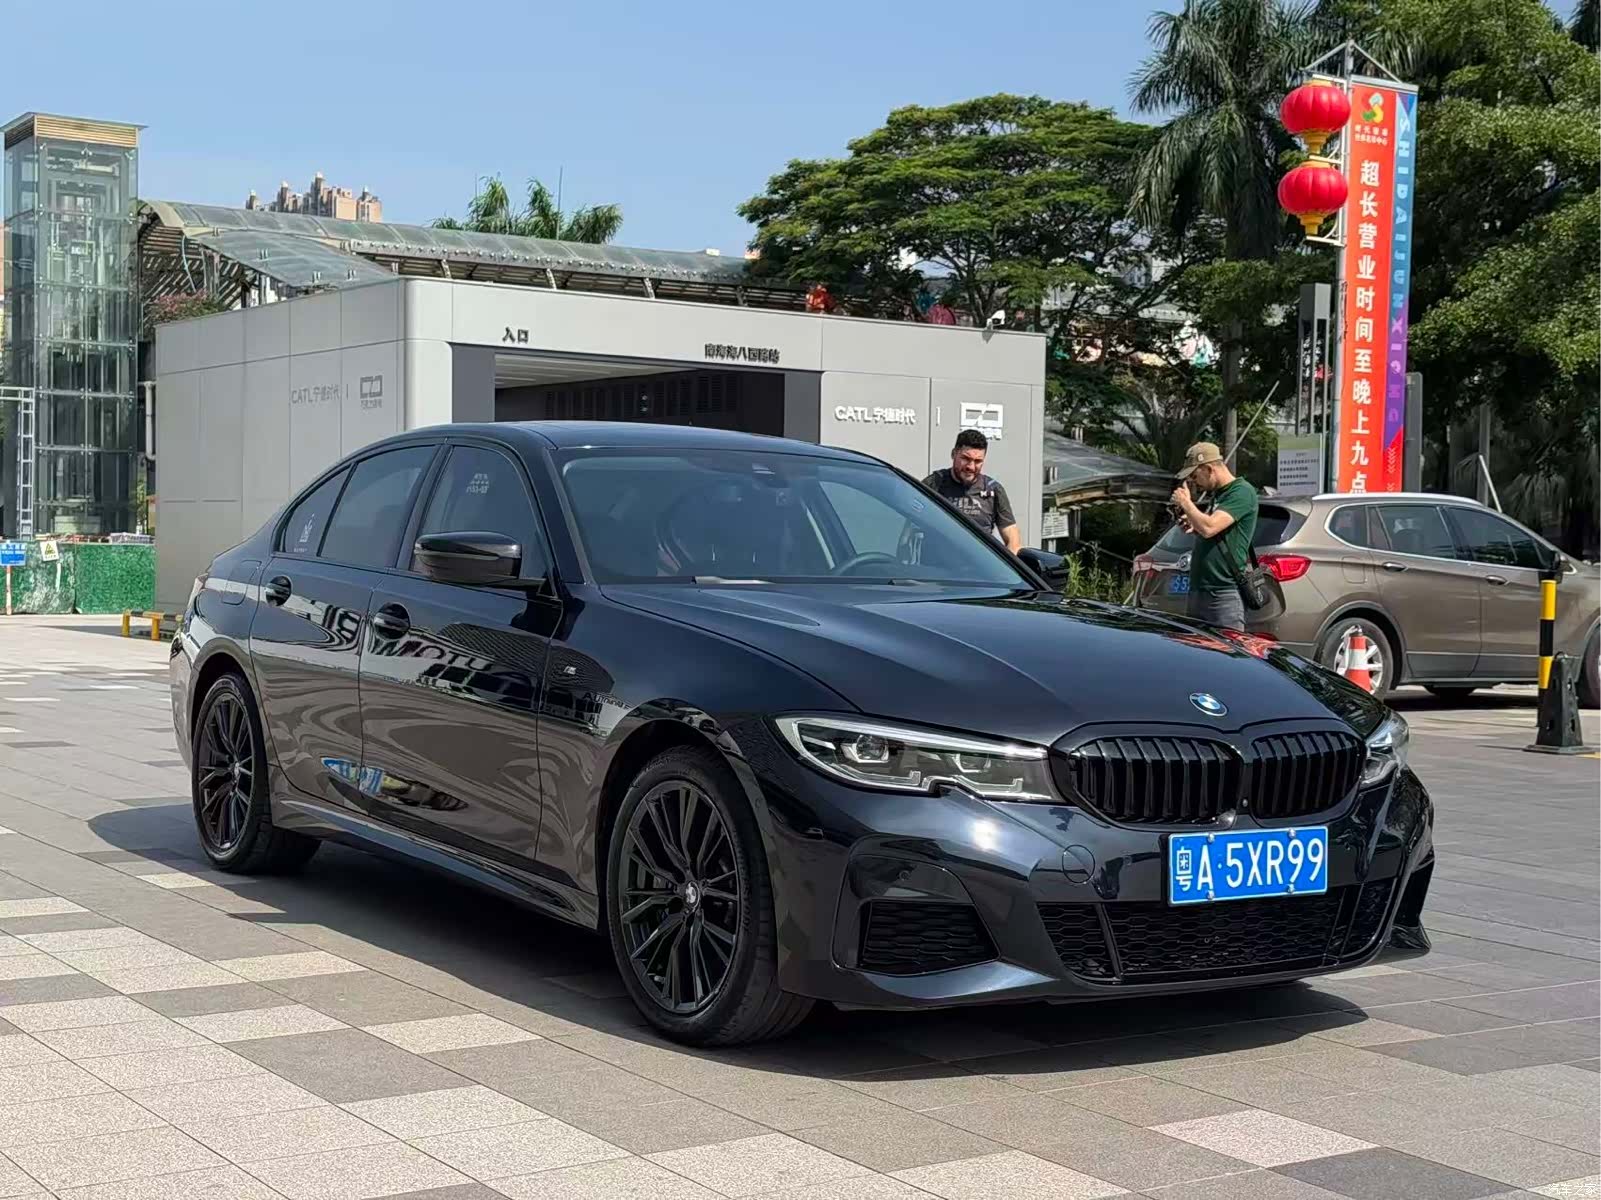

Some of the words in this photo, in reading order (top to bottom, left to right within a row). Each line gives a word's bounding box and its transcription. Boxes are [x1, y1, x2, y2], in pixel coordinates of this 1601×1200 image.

[502, 326, 529, 344] 入口
[1350, 159, 1380, 494] 超长营业时间至晚上九点
